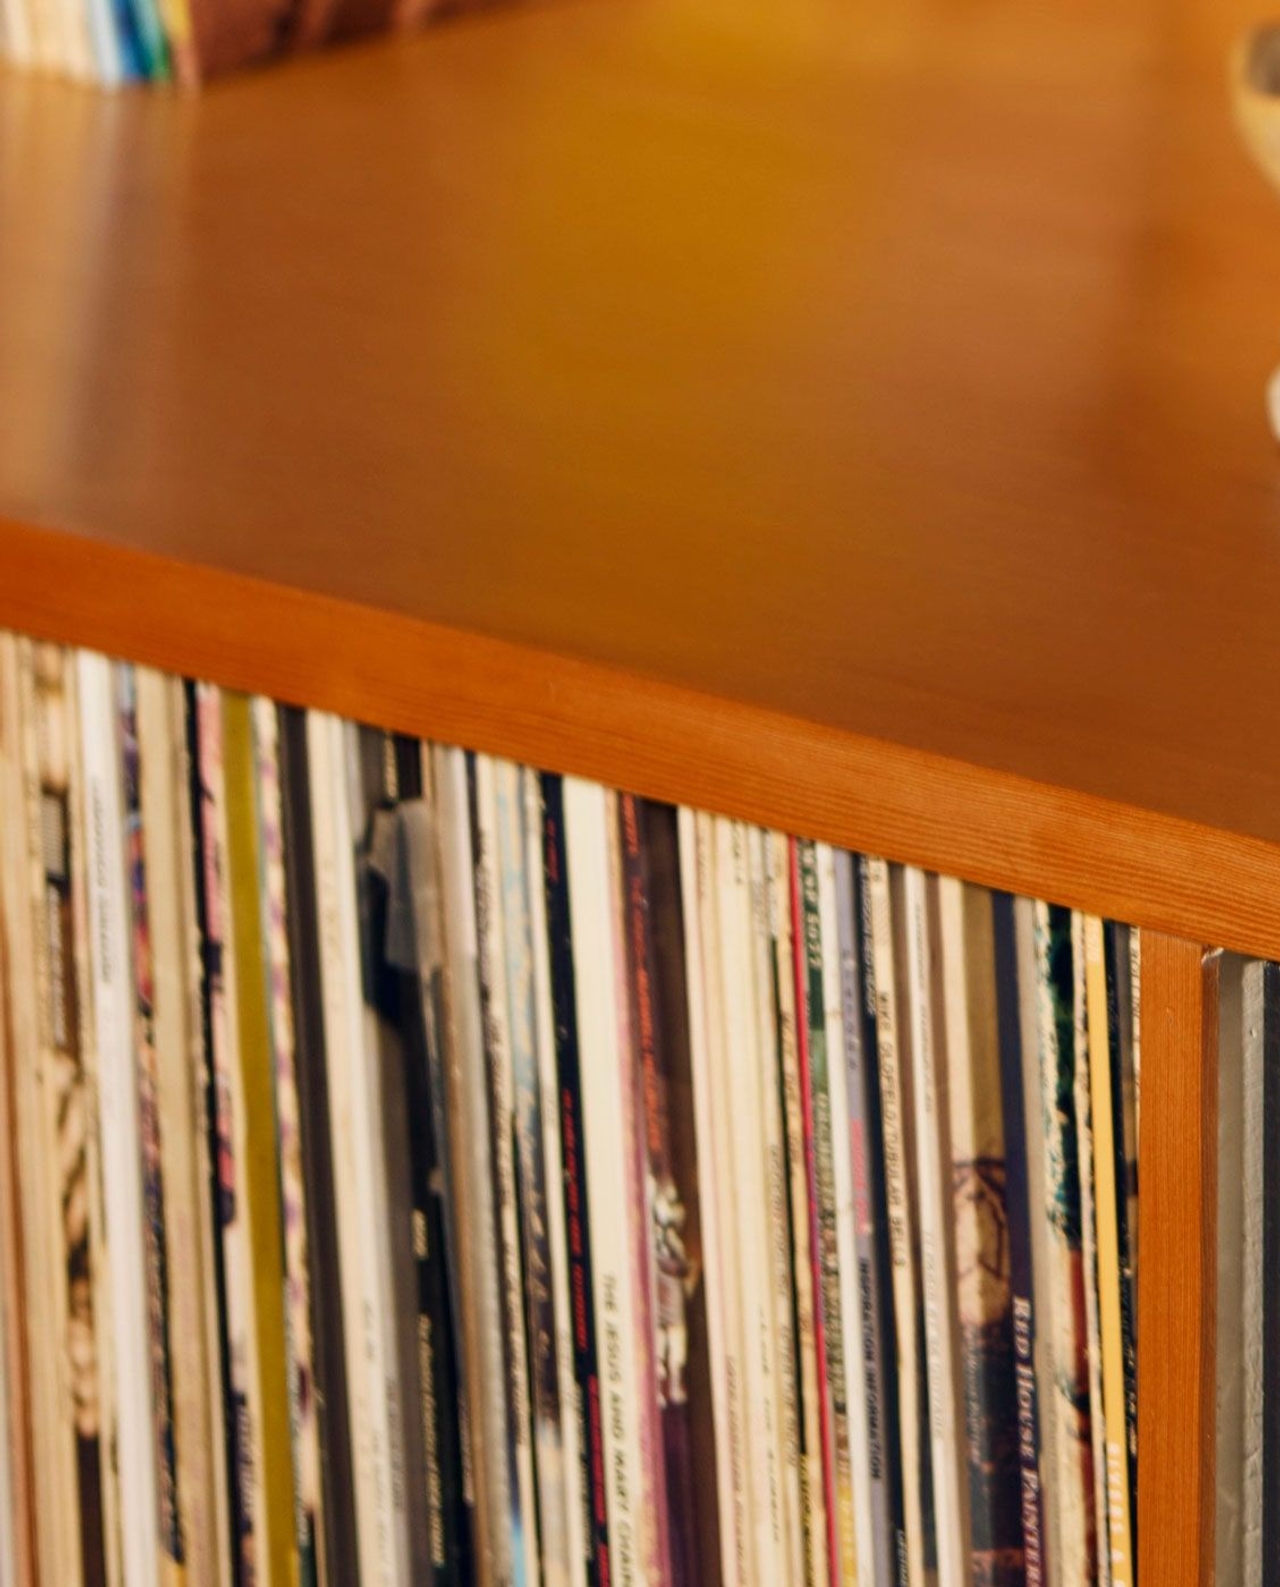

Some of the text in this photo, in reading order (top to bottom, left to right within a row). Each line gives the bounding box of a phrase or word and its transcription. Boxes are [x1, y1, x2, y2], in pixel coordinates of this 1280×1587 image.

[604, 1274, 619, 1314] THE
[605, 1322, 624, 1384] JESUS
[1012, 1295, 1032, 1358] RED
[857, 1257, 882, 1480] INSPIRATION INFORMATION
[610, 1390, 627, 1441] AND
[1016, 1362, 1035, 1459] HOUSE
[614, 1449, 632, 1515] MARY
